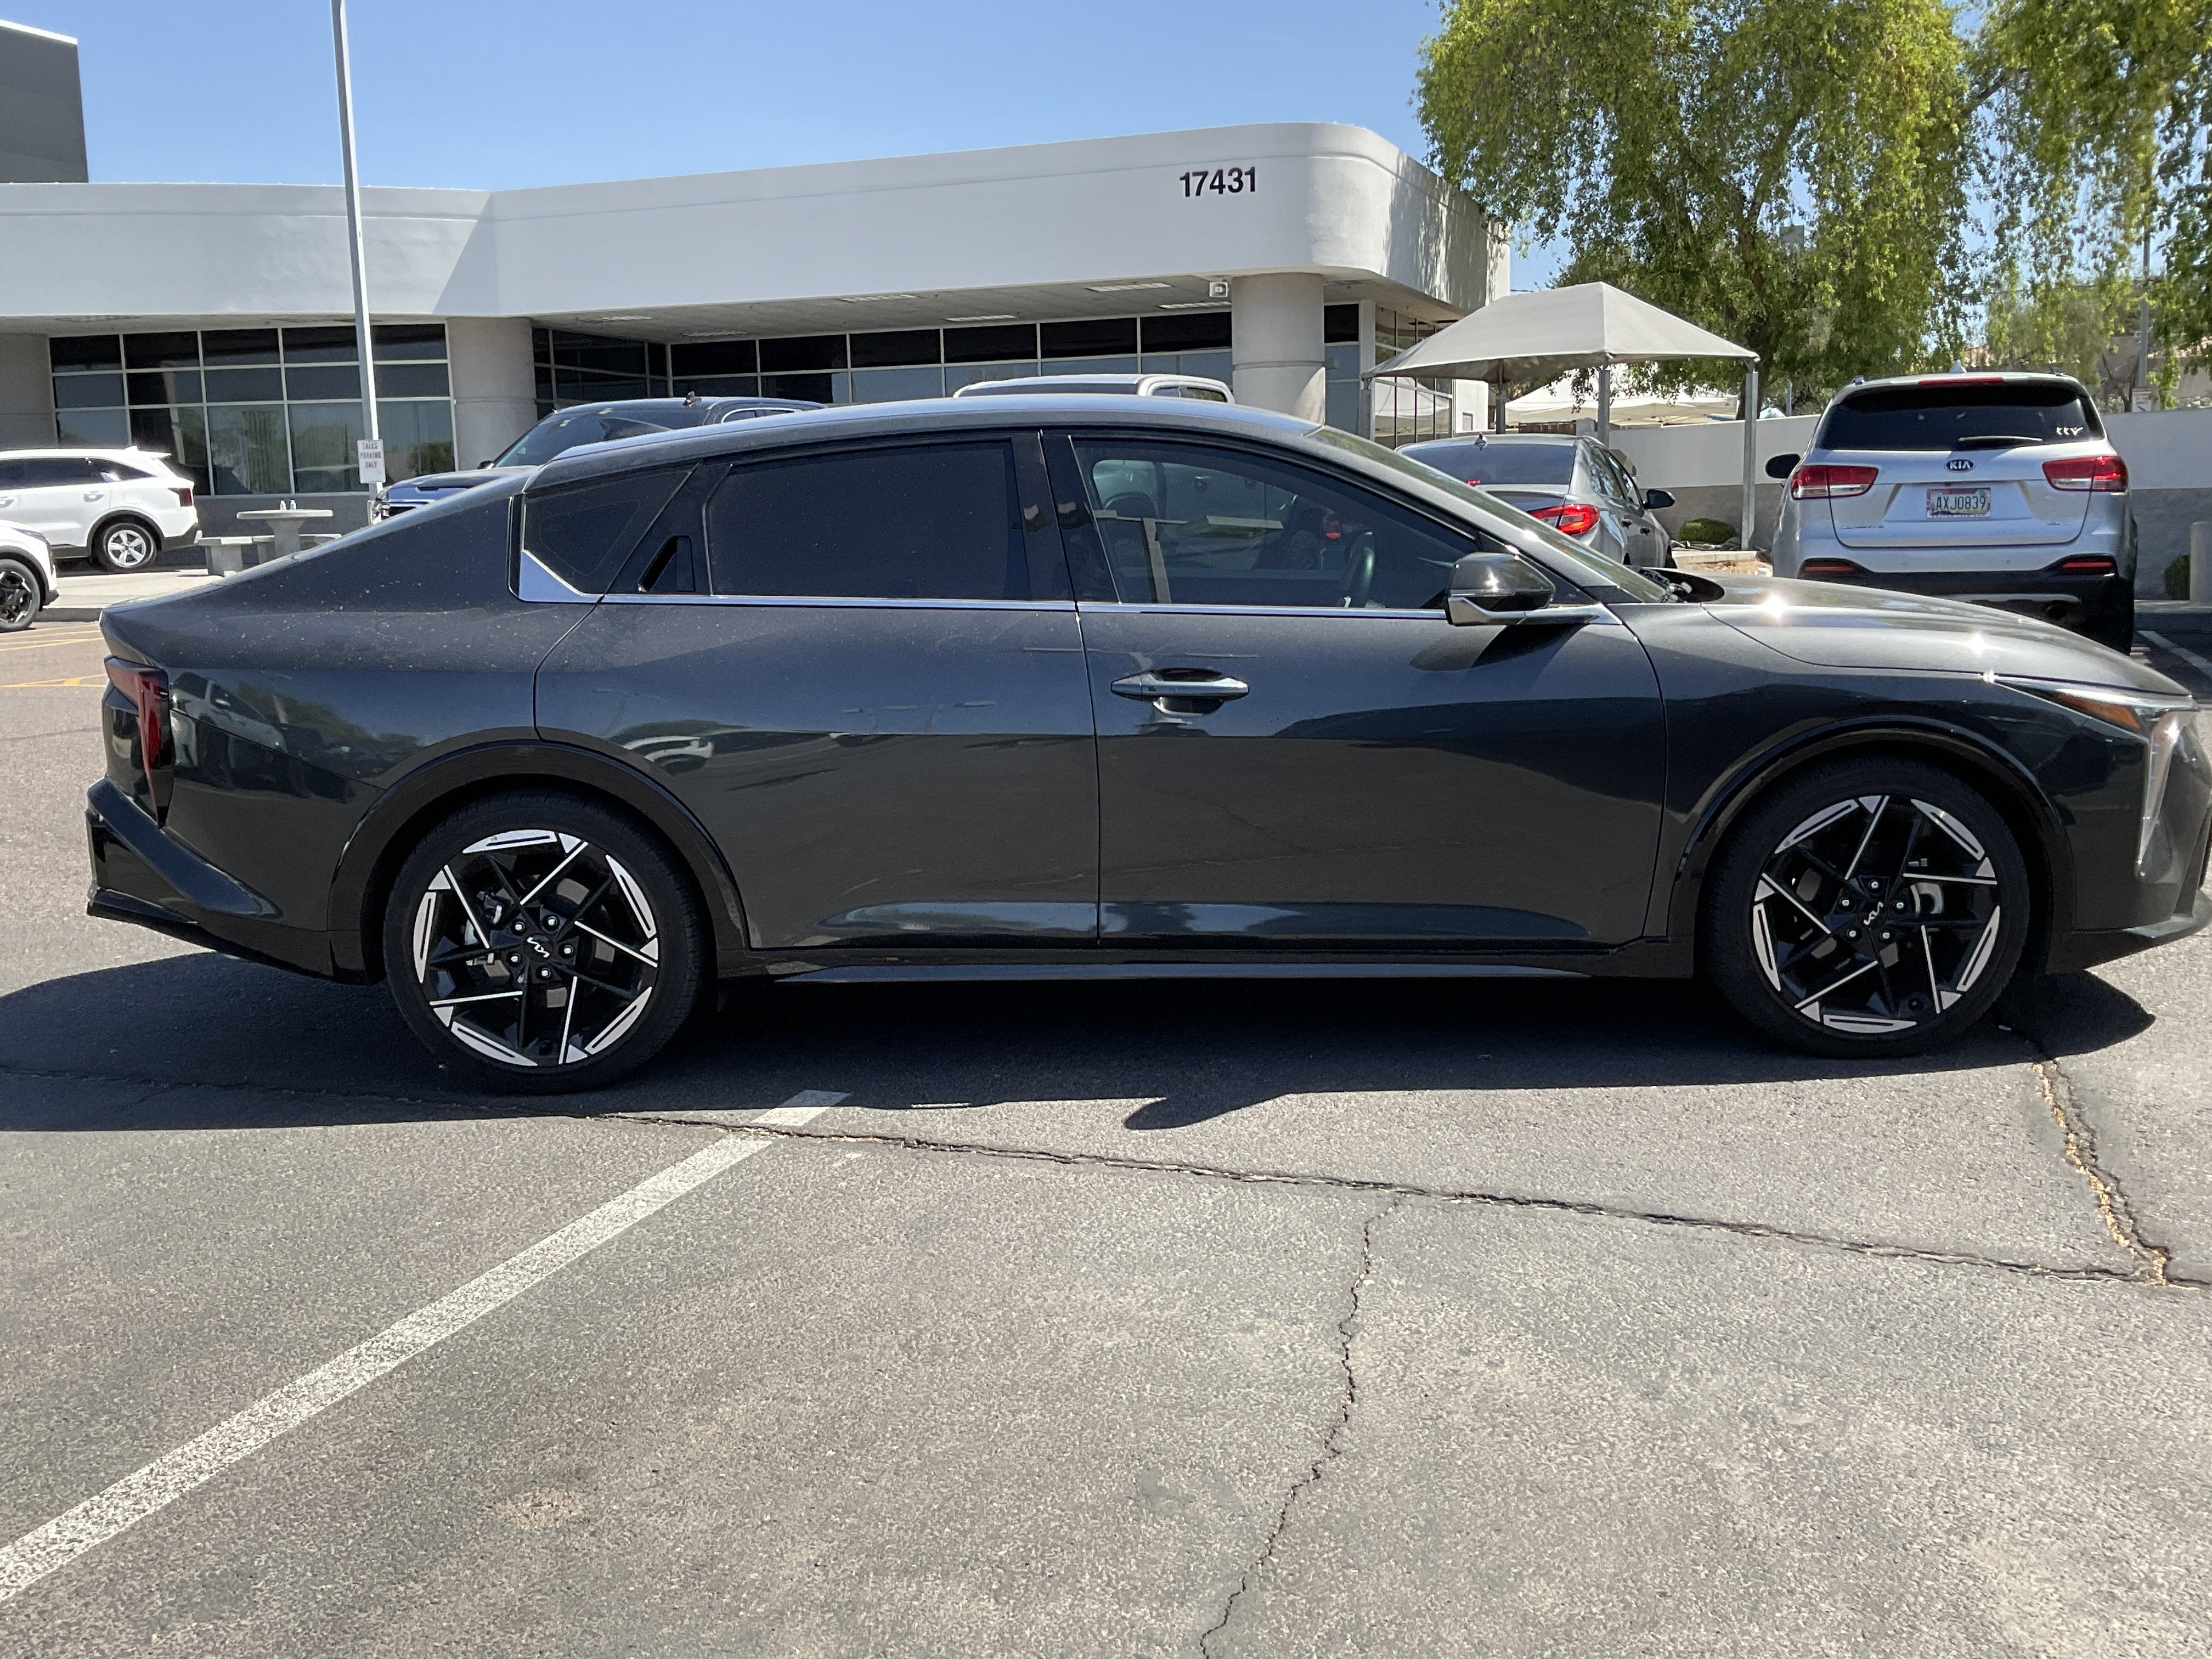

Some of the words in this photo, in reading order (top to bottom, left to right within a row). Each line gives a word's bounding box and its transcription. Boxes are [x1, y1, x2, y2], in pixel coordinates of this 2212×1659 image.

[1180, 166, 1256, 197] 17431
[1949, 460, 1971, 470] KIA
[1936, 495, 1986, 511] AXJ0839
